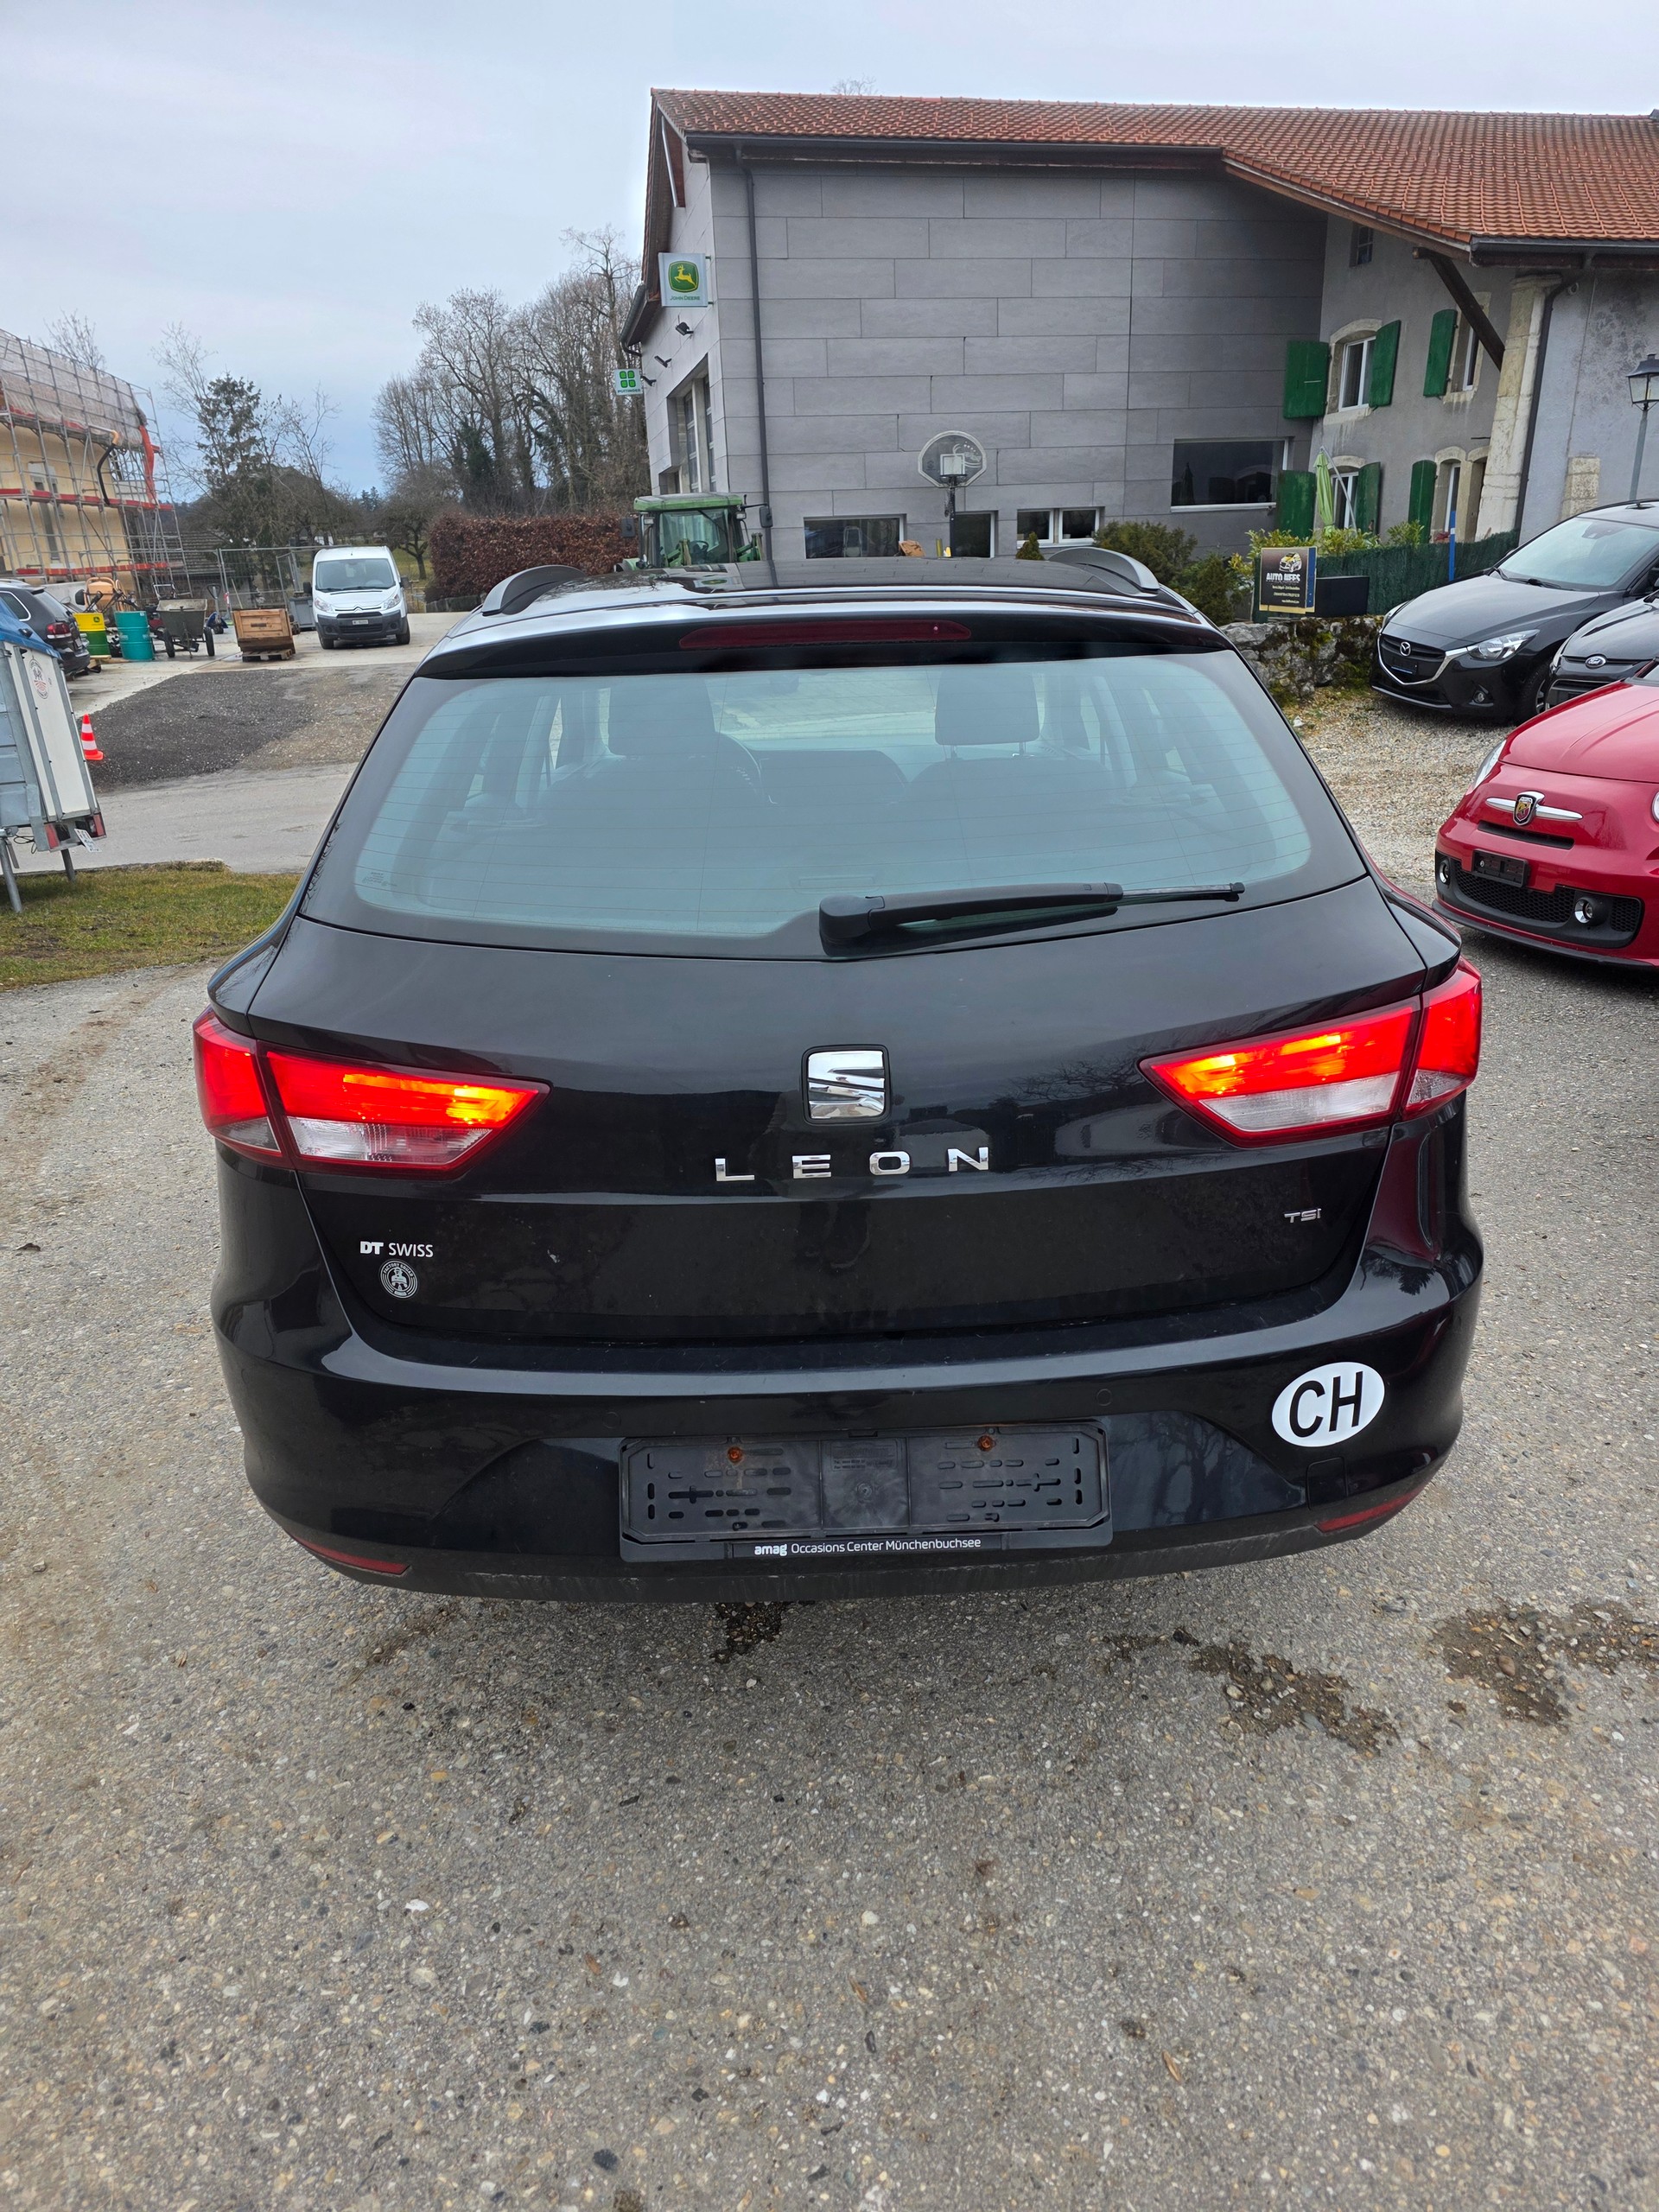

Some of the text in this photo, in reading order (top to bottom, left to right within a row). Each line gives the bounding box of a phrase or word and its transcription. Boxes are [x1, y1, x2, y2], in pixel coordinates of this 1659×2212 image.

[715, 1147, 989, 1181] LEON
[1284, 1208, 1322, 1224] TSI
[359, 1241, 434, 1257] DT SWISS
[383, 1263, 400, 1274] FACTORY
[1289, 1370, 1363, 1438] CH
[754, 1538, 982, 1557] amag Occasions Center Münchenbuchsee
